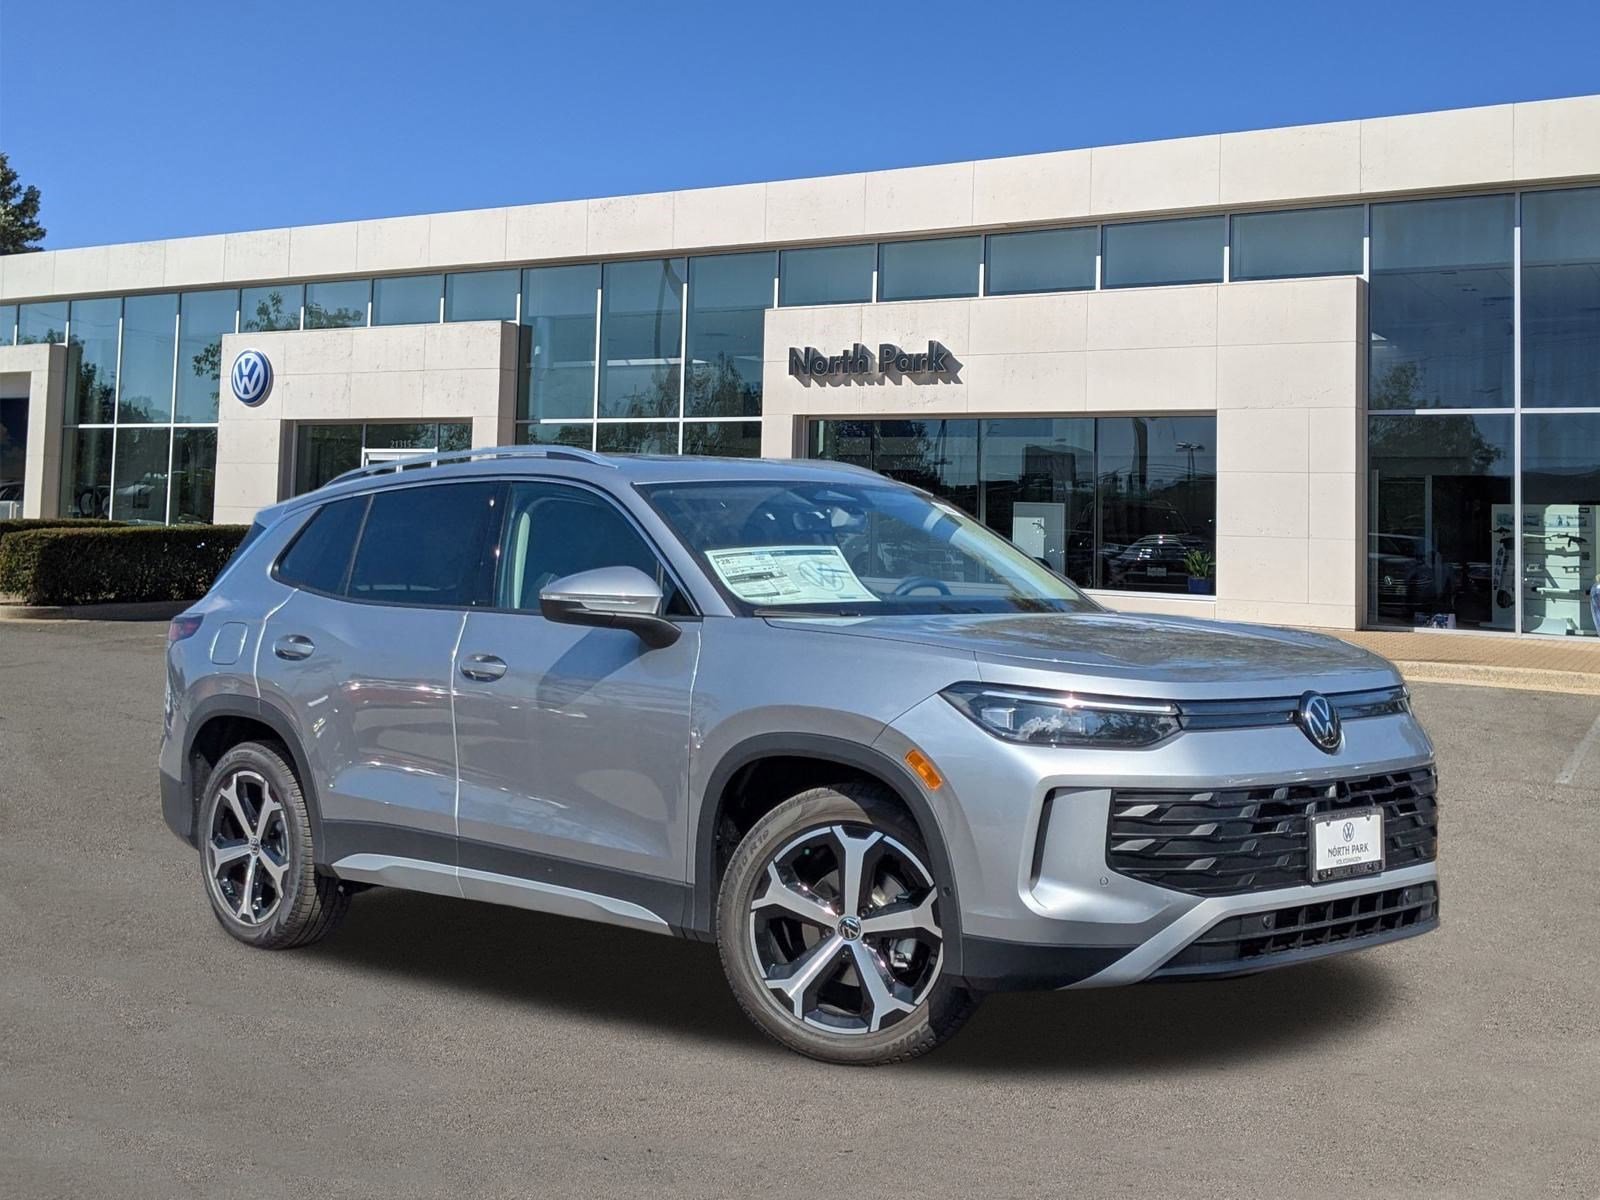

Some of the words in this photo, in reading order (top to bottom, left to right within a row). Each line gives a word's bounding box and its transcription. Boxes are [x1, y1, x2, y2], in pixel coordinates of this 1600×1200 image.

[789, 343, 872, 376] North
[879, 340, 948, 374] Park
[232, 350, 270, 404] VW
[390, 440, 412, 449] 21315
[1306, 695, 1337, 749] VW
[1342, 822, 1355, 842] VW
[1327, 845, 1351, 858] NORTH
[1351, 842, 1369, 856] PARK
